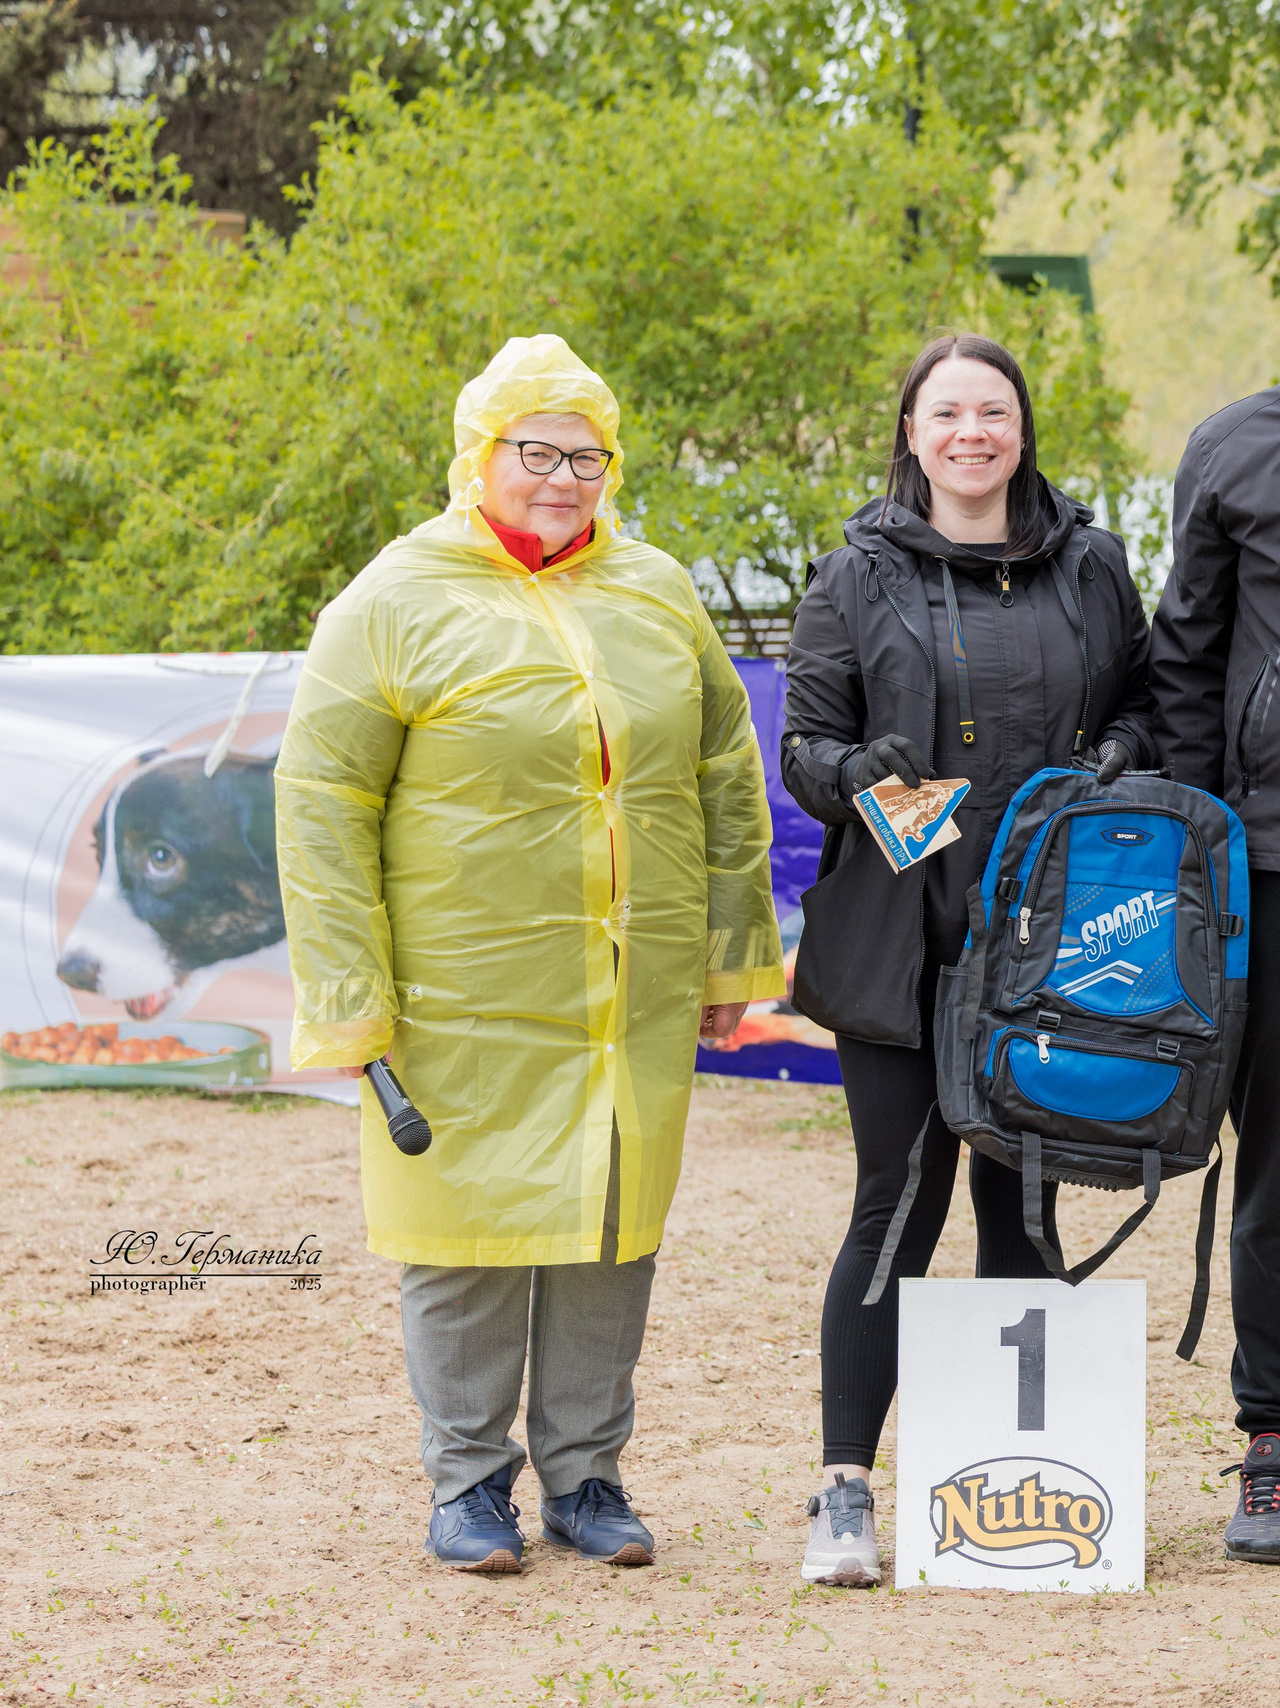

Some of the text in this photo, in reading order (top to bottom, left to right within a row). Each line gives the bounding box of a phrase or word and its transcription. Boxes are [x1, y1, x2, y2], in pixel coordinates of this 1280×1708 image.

[861, 795, 908, 864] Лучшая собака ПРК
[1080, 890, 1160, 963] SPORT
[1000, 1308, 1046, 1431] 1
[930, 1471, 1106, 1569] Nutro
